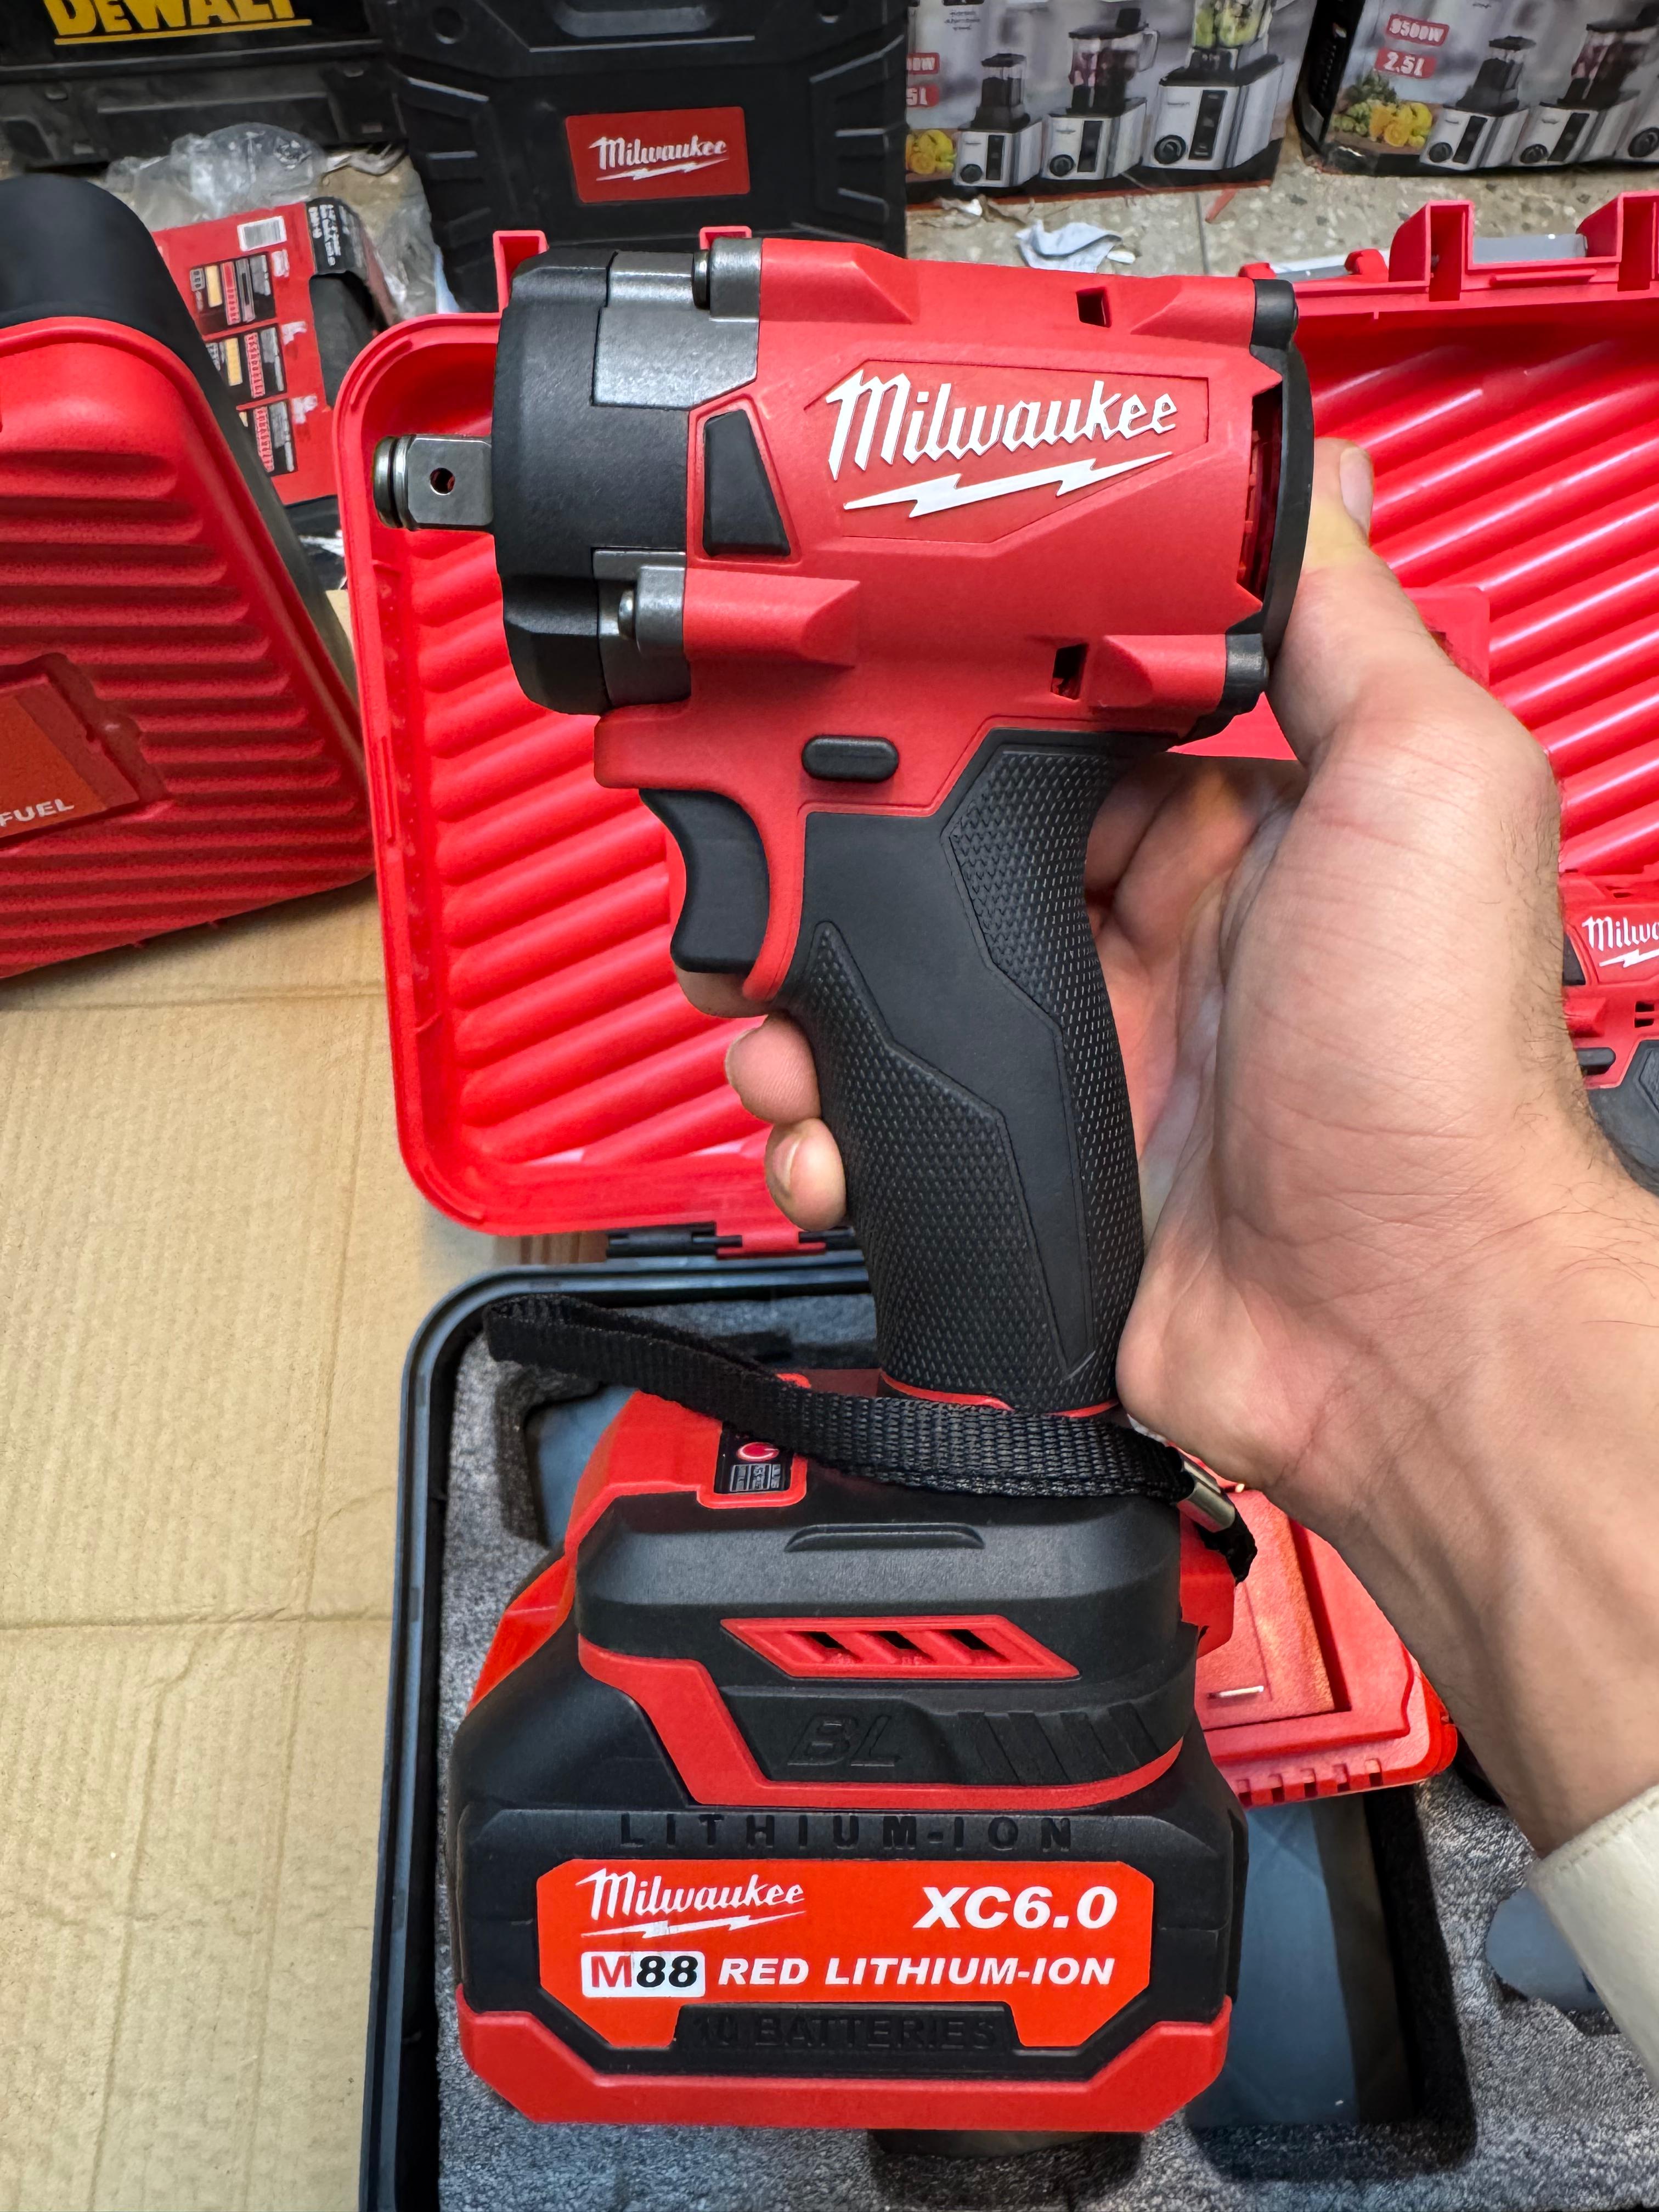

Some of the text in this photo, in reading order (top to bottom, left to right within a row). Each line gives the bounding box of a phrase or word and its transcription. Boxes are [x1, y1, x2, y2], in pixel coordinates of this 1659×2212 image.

[589, 135, 727, 170] Milwaukee
[826, 369, 1178, 481] Milwaukee
[0, 799, 75, 826] FUEL
[620, 1813, 1071, 1851] LITHIUM-ION
[576, 1868, 1118, 1929] Milwaukee XC6.0
[591, 1955, 1115, 1988] M88 RED LITHIUM-ION
[755, 2015, 998, 2050] BATTERIES
